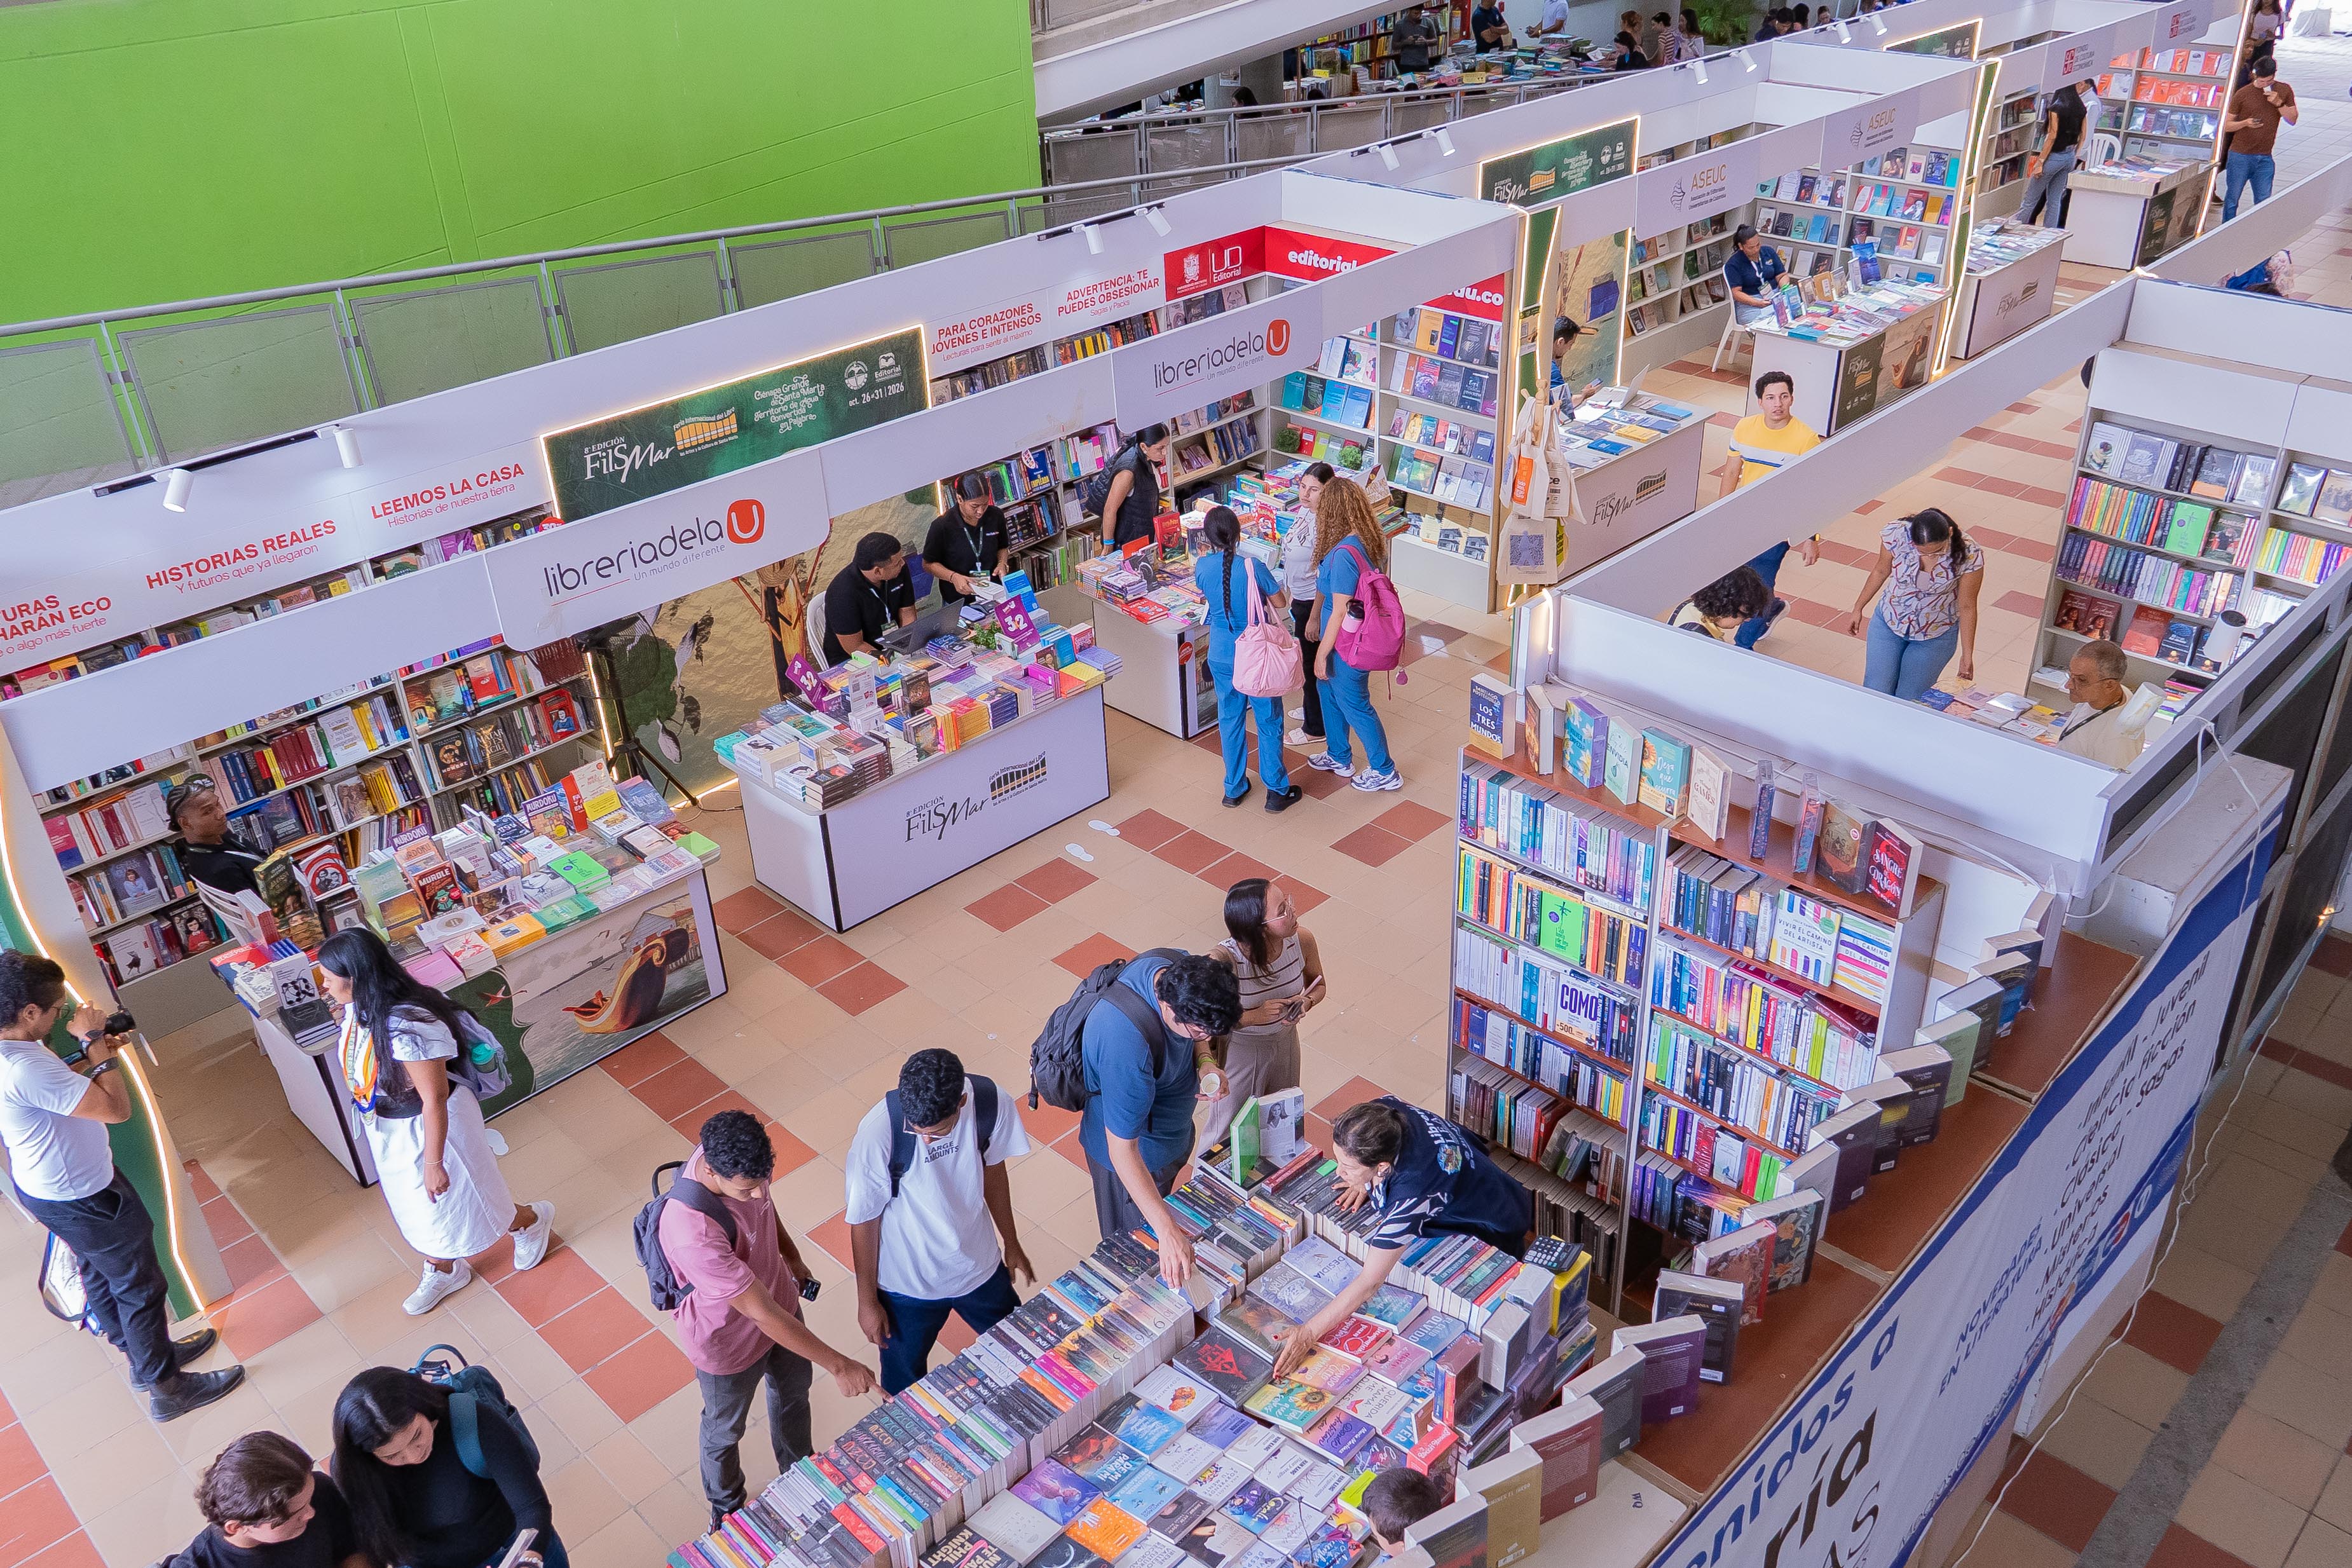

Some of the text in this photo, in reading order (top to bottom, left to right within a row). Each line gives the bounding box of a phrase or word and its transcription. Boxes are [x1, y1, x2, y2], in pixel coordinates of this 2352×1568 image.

[1867, 107, 1896, 132] ASEUC
[1691, 163, 1727, 191] ASEUC
[1066, 269, 1149, 303] ADVERTENCIA: TE
[1213, 268, 1241, 283] Editorial
[1058, 296, 1096, 317] PUEDES
[1097, 278, 1160, 308] OBSESIONAR
[1090, 299, 1130, 318] Sagas y Packs
[931, 313, 1043, 355] JÓVENES E INTENSOS
[938, 303, 1034, 339] PARA CORAZONES
[942, 329, 1034, 362] Lecturas para sentir al máximo
[874, 365, 901, 379] Editorial
[1207, 353, 1265, 381] Un mundo diferente
[770, 383, 825, 407] de Santa Marta
[782, 374, 810, 392] Grande
[849, 382, 905, 407] oct. 26 31 2026
[673, 421, 685, 431] Feria
[685, 416, 716, 425] Internacional
[723, 407, 735, 418] Libro
[754, 395, 819, 422] Territorio de Agua
[770, 407, 806, 423] Convertida
[592, 436, 625, 453] EDICIÓN
[371, 463, 525, 519] LEEMOS LA CASA
[387, 482, 516, 528] Historias de nuestra tierra
[146, 519, 336, 590] HISTORIAS REALES
[634, 543, 726, 582] Un mundo diferente
[175, 543, 318, 594] Y futuros que ya llegaron
[0, 595, 60, 623] URAS
[69, 597, 111, 620] ECO
[6, 616, 107, 655] o algo más fuerte
[1475, 685, 1498, 700] SANTIAGO
[1476, 713, 1496, 730] TRES
[1479, 703, 1493, 717] LOS
[1470, 721, 1502, 744] MUNDOS
[989, 771, 1000, 782] Feria
[1000, 761, 1028, 774] Internacional
[1035, 751, 1046, 763] Libro
[1608, 742, 1629, 768] ENVIDIA
[913, 795, 944, 816] EDICIÓN
[1873, 848, 1905, 880] SANGRE
[1778, 918, 1796, 931] VIVIR
[1806, 931, 1833, 947] CAMINO
[1784, 929, 1824, 951] DEL ARTISTA
[1845, 948, 1886, 971] DEL ARTISTA
[1861, 941, 1889, 958] CAMINO
[1560, 984, 1598, 1021] COMO
[924, 1145, 959, 1164] AMOUNTS
[928, 1140, 954, 1156] LARGE
[2051, 1135, 2125, 1251] Universal
[1313, 1255, 1346, 1279] DESIDIA
[1955, 1215, 2043, 1353] NOVEDADES
[1153, 1317, 1165, 1329] 9
[1408, 1311, 1442, 1344] OLVIDO
[1938, 1355, 1962, 1398] EN
[1964, 1236, 2044, 1363] LITERATURA
[1870, 1314, 1900, 1371] a
[1112, 1353, 1125, 1363] 3
[1364, 1380, 1378, 1394] ME
[1364, 1386, 1397, 1422] QUERIDA
[1106, 1452, 1130, 1473] PARA
[1116, 1460, 1132, 1475] DE
[1200, 1476, 1221, 1495] MENTE
[1205, 1468, 1239, 1497] SORPRENDE
[926, 1527, 974, 1567] KNIGHT
[942, 1539, 973, 1567] PHIL
